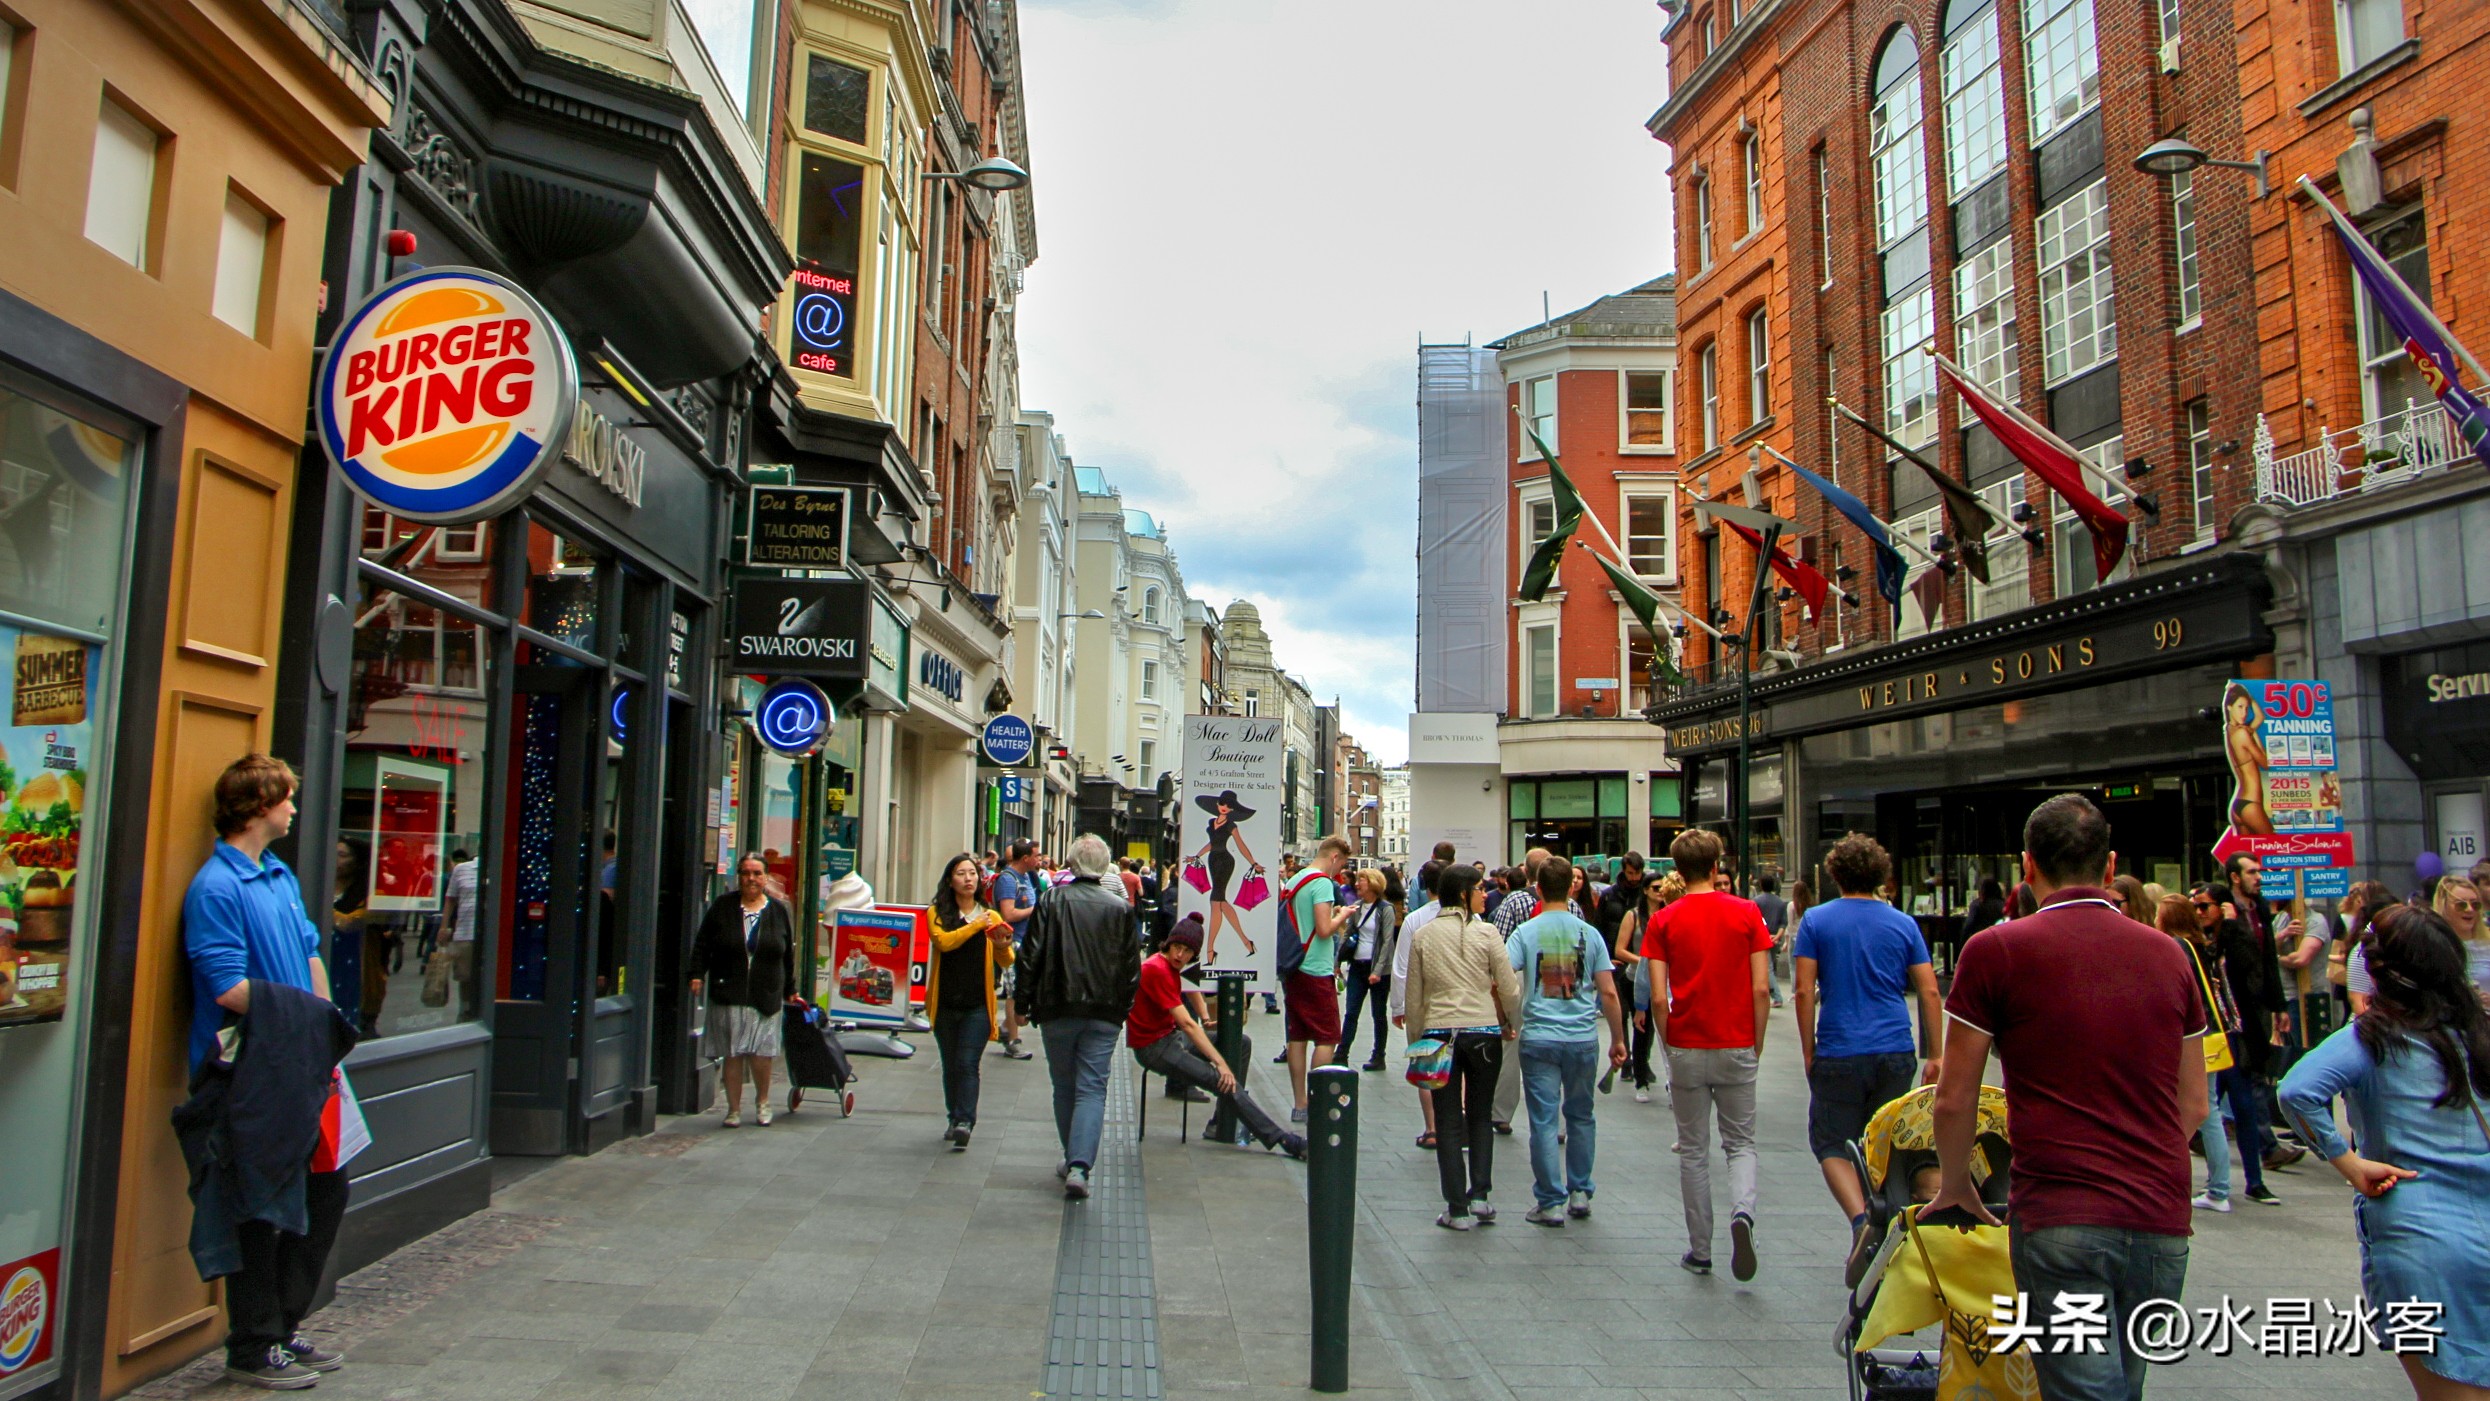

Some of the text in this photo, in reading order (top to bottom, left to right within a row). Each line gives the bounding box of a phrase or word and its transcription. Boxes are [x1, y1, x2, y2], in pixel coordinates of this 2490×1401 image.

[794, 269, 851, 295] internet
[796, 293, 843, 348] @
[345, 318, 531, 397] BURGER
[800, 352, 836, 371] cafe
[343, 358, 535, 462] KING
[564, 399, 645, 508] ROVSKI
[758, 494, 837, 515] Des Byrne
[764, 523, 831, 540] TAILORING
[752, 545, 839, 562] ALTERATIONS
[740, 635, 855, 659] SWAROVSKI
[17, 649, 84, 686] SUMMER
[1859, 617, 2182, 710] WEIR & SONS 99
[16, 686, 83, 714] BARBECUE
[408, 693, 469, 765] SALE
[763, 692, 820, 746] @
[2264, 720, 2332, 734] TANNING
[991, 725, 1026, 737] HEALTH
[1188, 720, 1280, 743] Mac Doll
[1672, 726, 1700, 748] WEIR
[1709, 718, 1741, 743] SONS
[987, 738, 1030, 751] MATTERS
[1201, 744, 1265, 770] Boutique
[1193, 780, 1275, 790] Designer Hire & Sales
[1220, 769, 1245, 778] Grafton
[1246, 771, 1265, 779] Street
[2270, 778, 2310, 789] 2015
[1006, 780, 1017, 798] S
[2270, 790, 2312, 798] SUNBEDS
[2448, 836, 2476, 856] AIB
[2272, 857, 2302, 865] GRAFTON
[2303, 855, 2326, 863] STREET
[2260, 874, 2288, 882] LLAGHT
[2311, 887, 2343, 895] SWORDS
[0, 1280, 41, 1324] BURGER
[0, 1296, 41, 1345] KING
